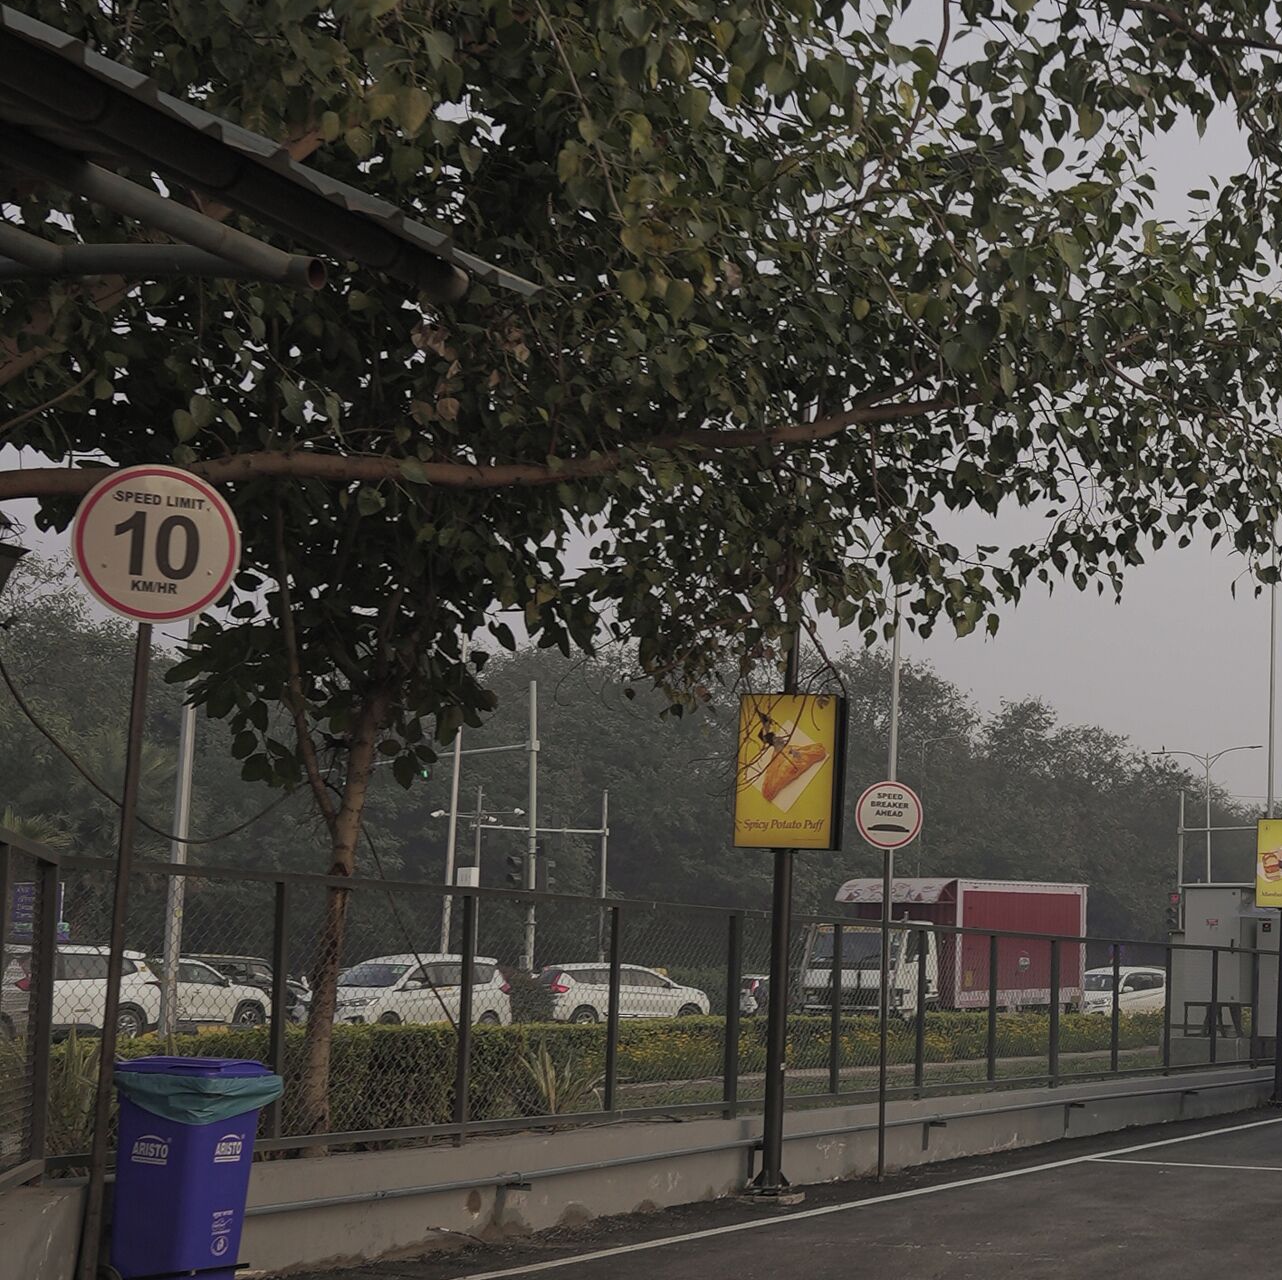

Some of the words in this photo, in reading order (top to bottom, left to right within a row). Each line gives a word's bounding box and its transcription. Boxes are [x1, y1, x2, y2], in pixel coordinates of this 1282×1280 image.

[113, 490, 162, 506] SPEED
[166, 495, 205, 511] LIMIT
[114, 510, 200, 580] 10
[130, 580, 177, 594] KM/HR
[877, 792, 904, 800] SPEED
[870, 800, 909, 809] BREAKER
[743, 818, 769, 831] Spicy
[770, 819, 802, 830] Potato
[803, 818, 825, 832] Puff
[132, 1141, 169, 1158] ARISTO
[214, 1141, 242, 1156] ARISTO
